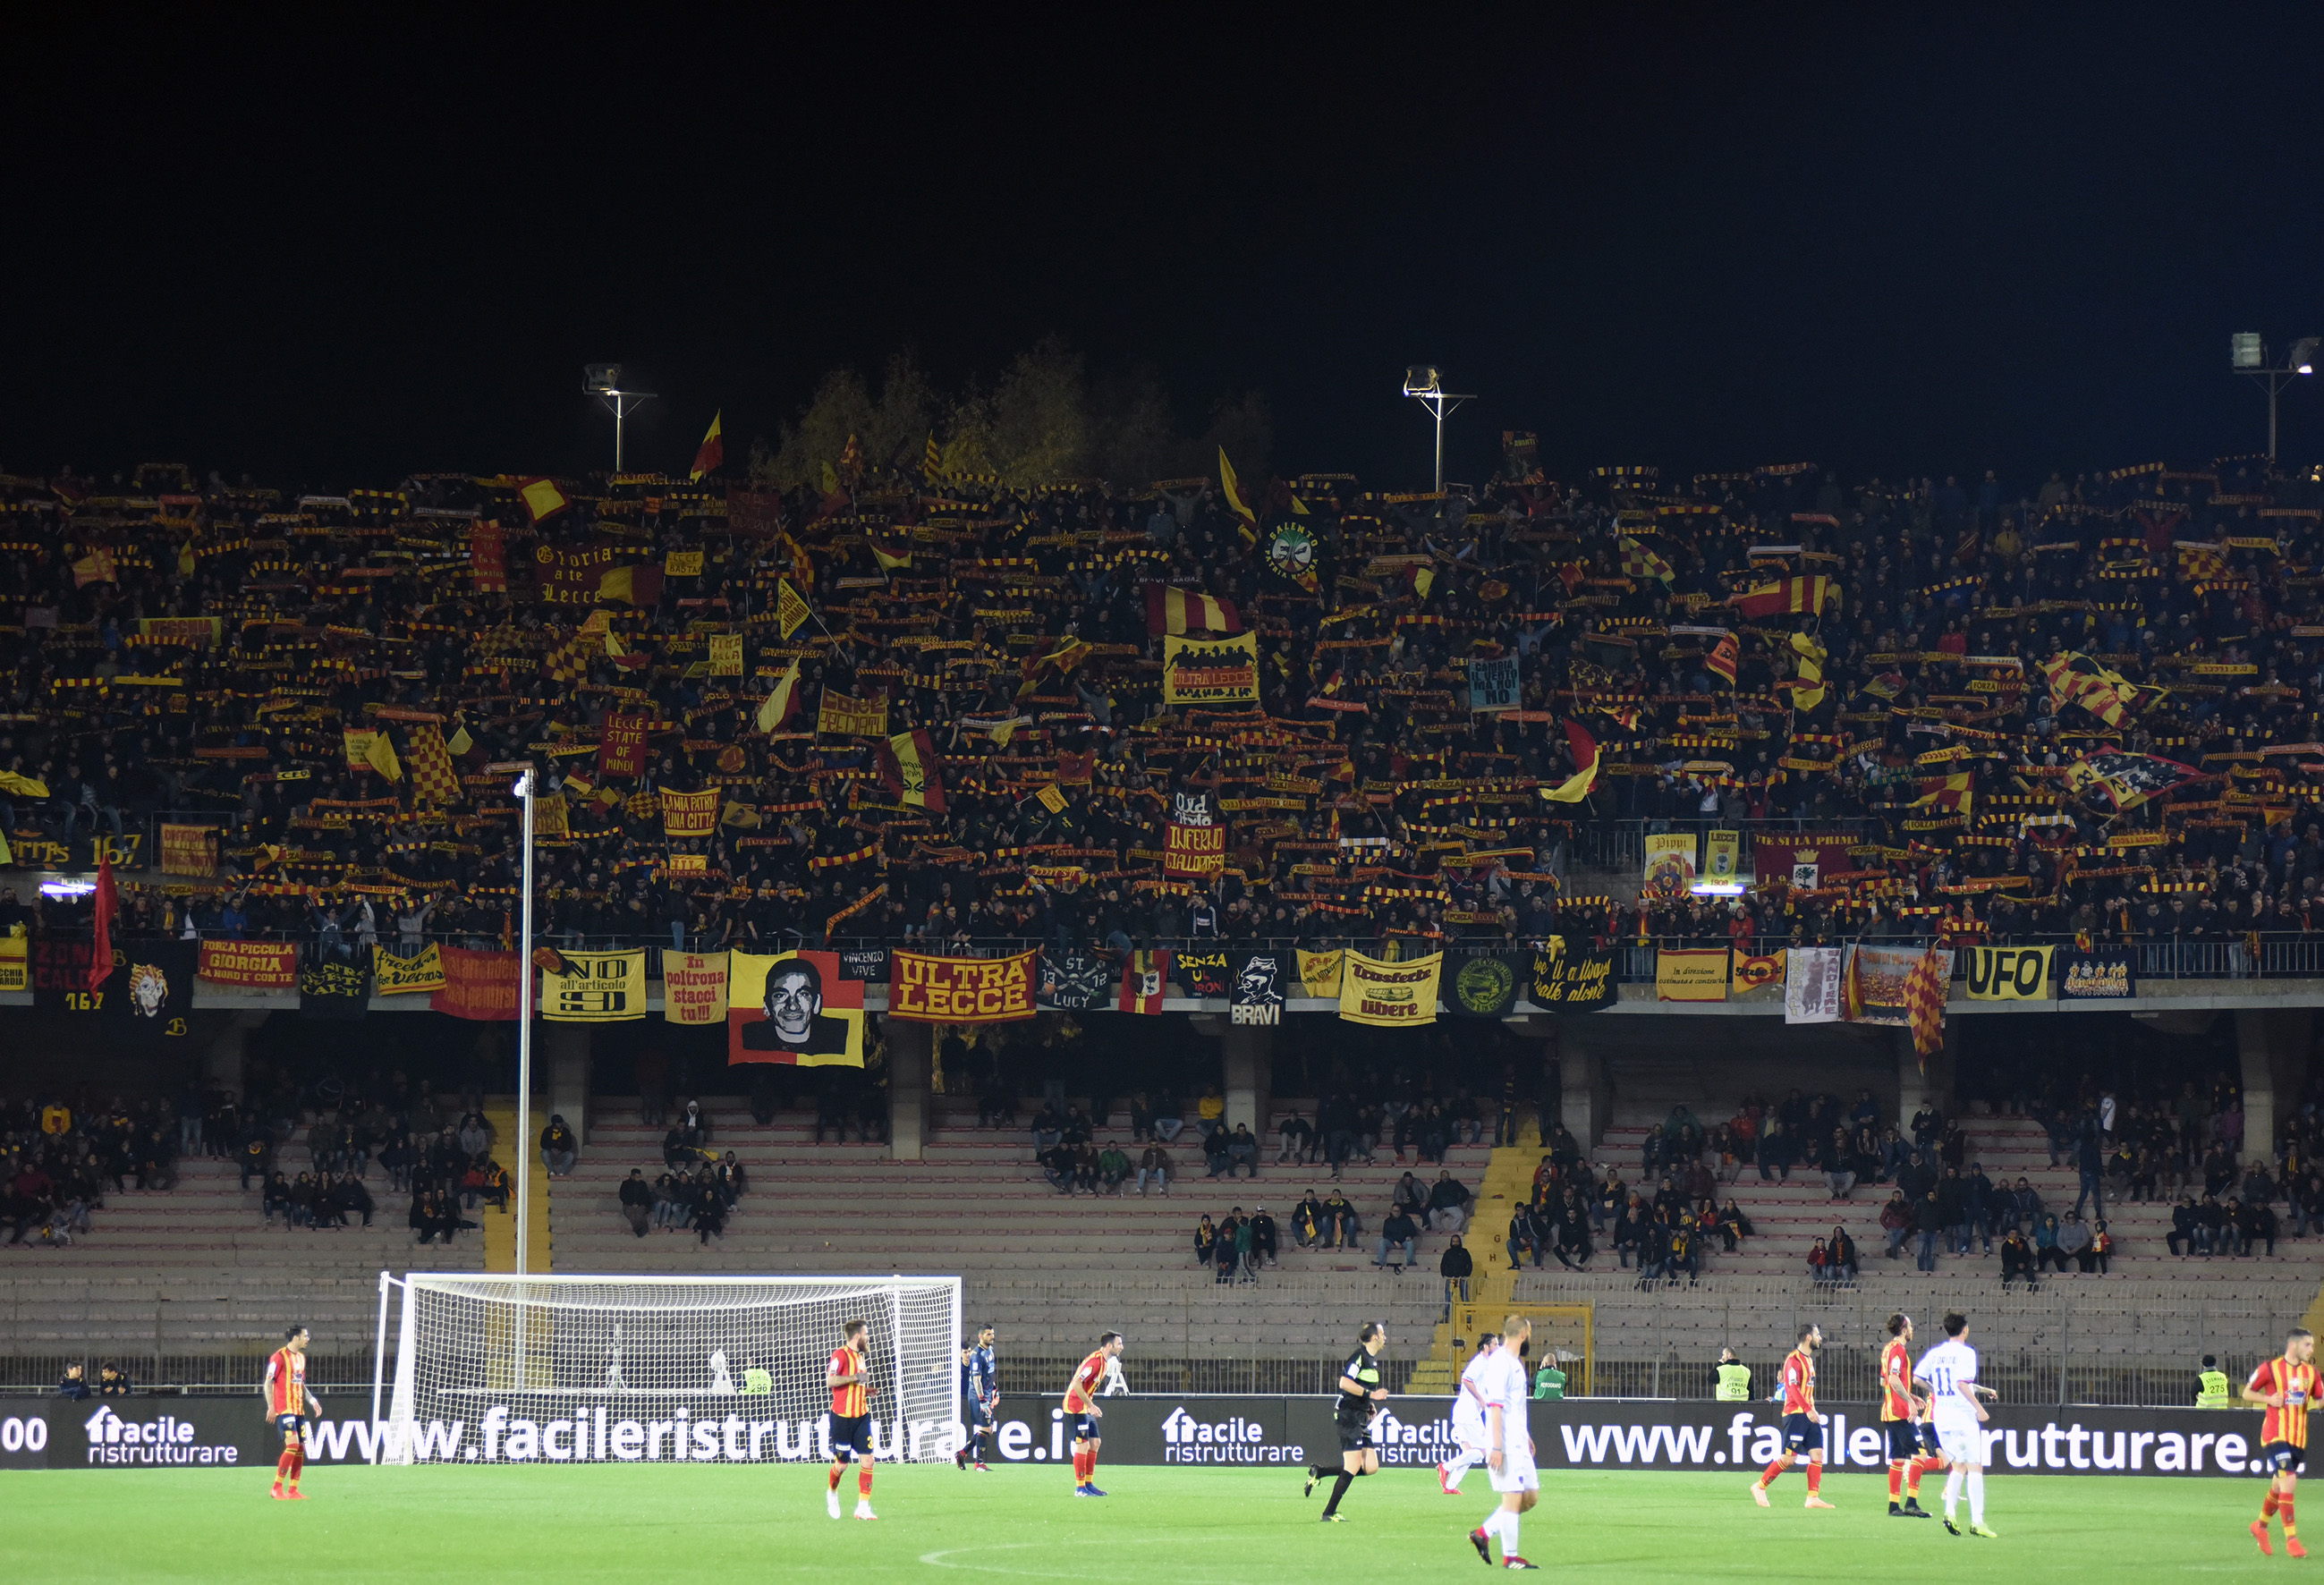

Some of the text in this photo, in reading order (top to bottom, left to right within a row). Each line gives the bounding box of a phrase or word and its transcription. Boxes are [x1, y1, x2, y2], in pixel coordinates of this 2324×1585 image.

[1270, 521, 1318, 547] SALENTO
[537, 545, 612, 567] Gloria
[569, 568, 583, 581] te
[542, 582, 604, 604] Lecce
[1474, 661, 1514, 673] CAMBIA
[1212, 671, 1253, 685] LECCE
[1473, 681, 1494, 691] MA
[1973, 681, 1996, 690] FORZA
[1485, 691, 1511, 705] NO
[608, 716, 644, 730] LECCE
[607, 731, 642, 744] STATE
[615, 746, 631, 757] OF
[691, 793, 717, 811] PATRIA
[1176, 792, 1208, 814] Old
[534, 815, 565, 833] ORD
[1912, 820, 1935, 829] FORZA
[1169, 826, 1224, 851] INFERNO
[1656, 837, 1687, 850] Pippi
[1711, 833, 1736, 842] LECCE
[1794, 836, 1811, 845] LA
[1817, 835, 1859, 846] PRIMA
[90, 834, 142, 867] 167
[1449, 912, 1472, 921] FORZA
[36, 941, 90, 965] ZON
[202, 940, 293, 955] FORZA PICCOLA
[209, 954, 283, 972] GIORGIA
[686, 955, 705, 969] In
[843, 951, 884, 963] VINCENZO
[1177, 953, 1227, 969] SENZA
[199, 967, 213, 978] LA
[215, 969, 240, 981] NORD
[255, 972, 276, 982] CON
[278, 973, 293, 982] TE
[560, 959, 627, 979] NO
[852, 965, 876, 977] VIVE
[899, 955, 1031, 990] ULTRA'
[1673, 967, 1715, 976] In direzione
[1968, 948, 2044, 996] UFO
[36, 967, 90, 990] CALD
[560, 979, 626, 990] all'articolo
[666, 970, 725, 987] poltrona
[1658, 977, 1688, 986] ostinata
[674, 987, 717, 1004] stacci
[897, 983, 1028, 1015] LECCE
[1567, 982, 1607, 1002] alone
[560, 990, 626, 1012] 9
[1053, 993, 1090, 1009] LUCY
[1361, 999, 1418, 1017] libere
[681, 1004, 710, 1021] tu!!!
[1230, 1004, 1281, 1025] BRAVI
[1489, 1253, 1497, 1262] H
[1935, 1368, 1956, 1396] 11
[2209, 1385, 2225, 1394] 275
[1, 1416, 48, 1453] 00
[88, 1442, 238, 1464] ristrutturare
[1165, 1442, 1304, 1462] ristrutturare
